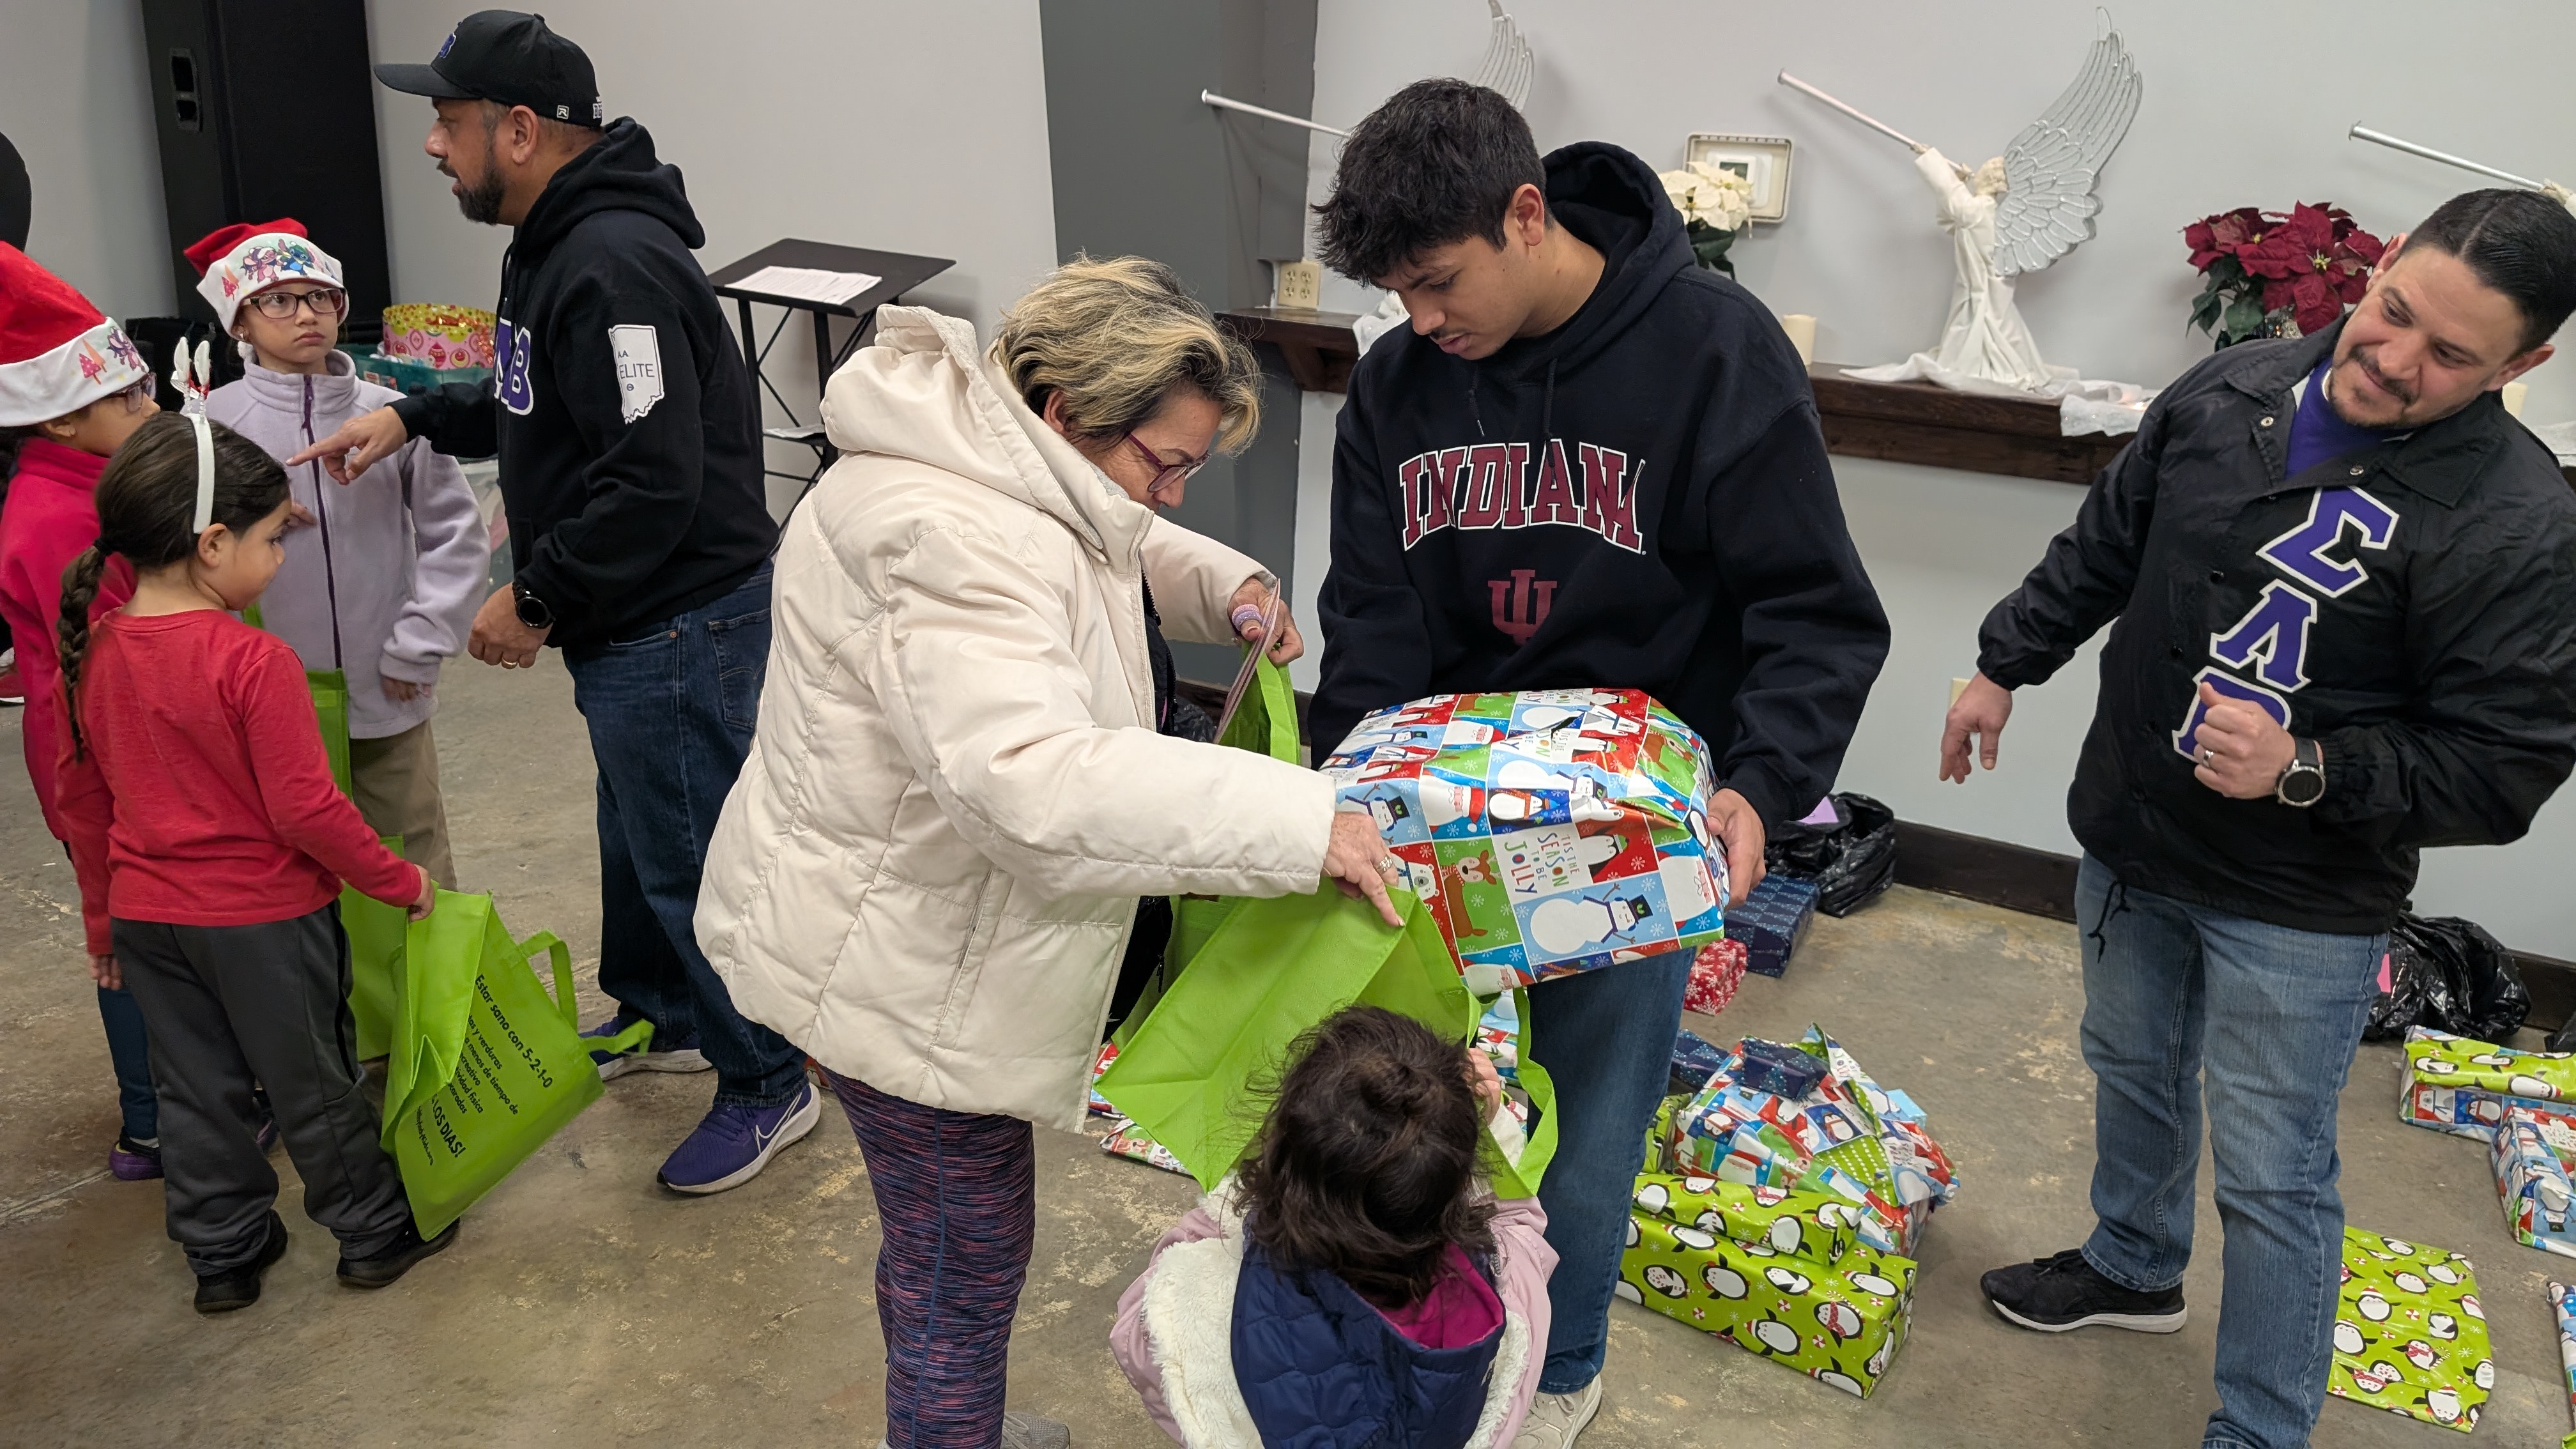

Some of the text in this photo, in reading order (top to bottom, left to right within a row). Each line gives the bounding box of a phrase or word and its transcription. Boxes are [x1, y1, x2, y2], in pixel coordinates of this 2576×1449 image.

[618, 363, 655, 379] ELITE
[1399, 438, 1646, 555] INDIANA
[1504, 841, 1538, 894] JOLLY
[1531, 850, 1547, 880] TO BE
[1537, 832, 1570, 887] SEASON
[1567, 855, 1580, 875] THE
[475, 974, 553, 1087] Estar sano con 5-2-1-0
[479, 1034, 503, 1070] verduras
[468, 1043, 484, 1068] menos
[483, 1068, 491, 1078] de
[489, 1077, 510, 1105] tiempo
[509, 1104, 519, 1115] de
[440, 1121, 466, 1158] DIAS!
